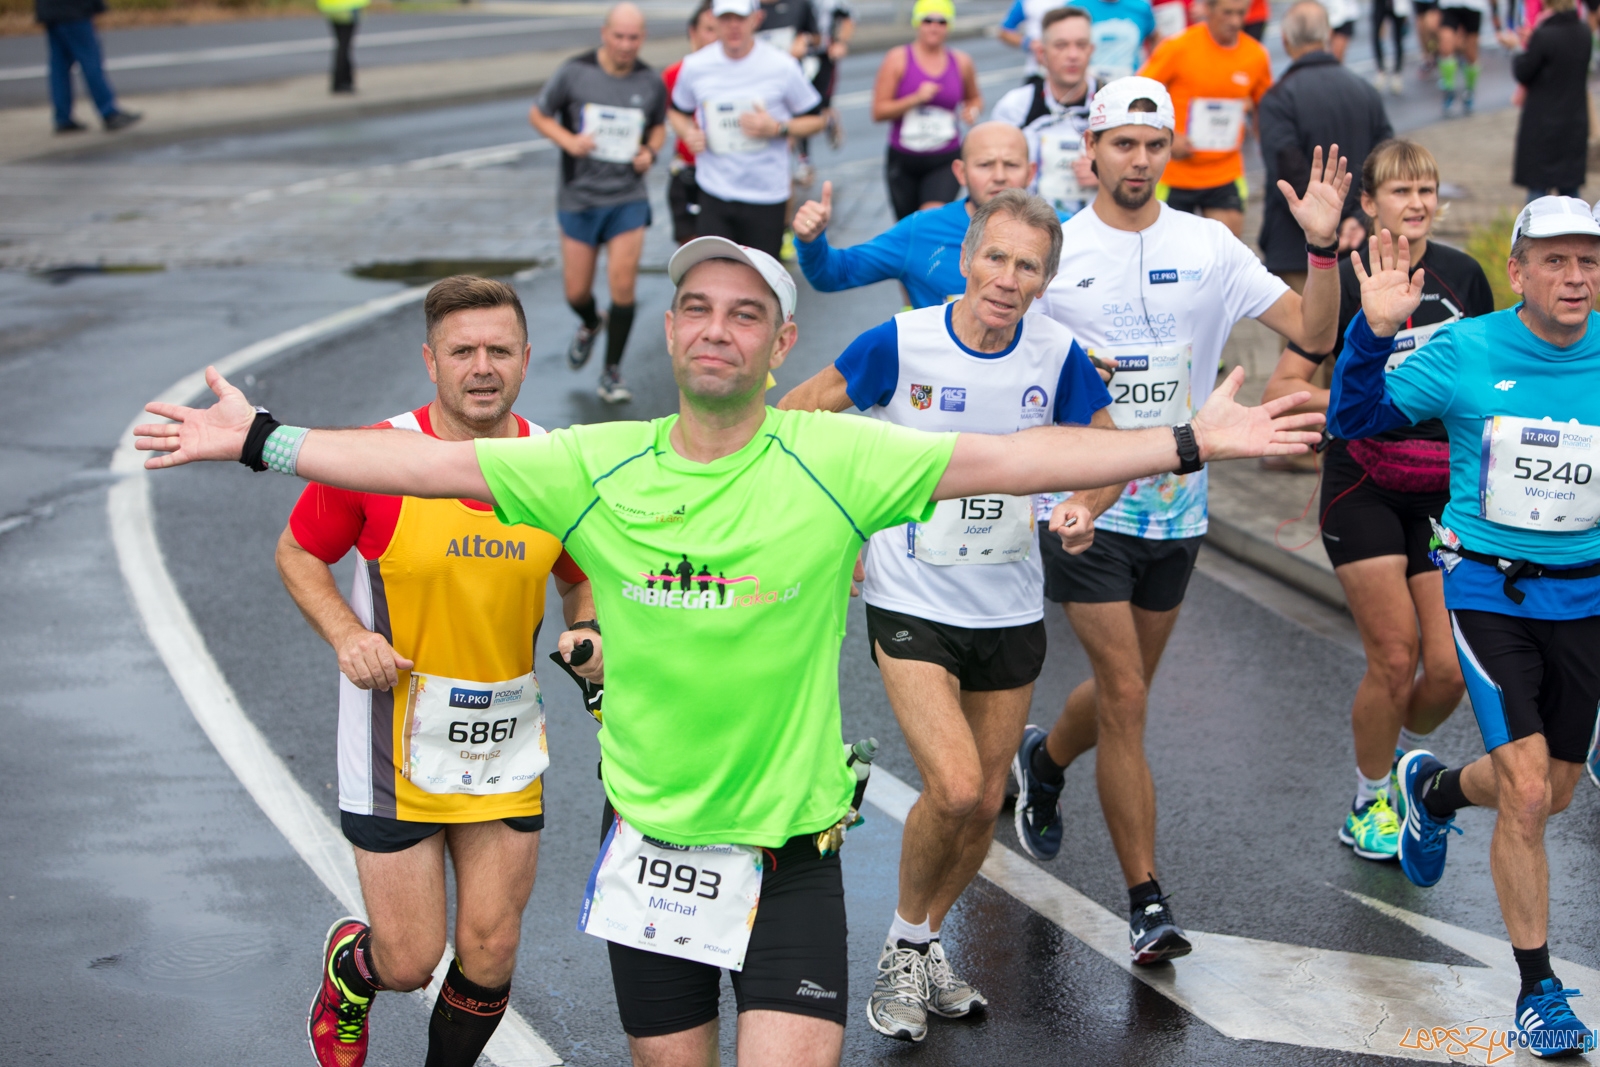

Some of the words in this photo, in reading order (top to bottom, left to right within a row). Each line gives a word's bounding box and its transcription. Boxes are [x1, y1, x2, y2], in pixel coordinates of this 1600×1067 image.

[1077, 277, 1096, 288] 4F
[1102, 302, 1133, 316] SIŁA
[1113, 313, 1176, 328] ODWAGA
[1104, 325, 1176, 342] SZYBKOŚĆ
[1114, 380, 1179, 404] 2067
[1494, 380, 1517, 391] 4F
[1135, 409, 1162, 419] Rafał
[1513, 456, 1593, 485] 5240
[1524, 486, 1576, 501] Wojciech
[960, 498, 1005, 520] 153
[963, 525, 993, 535] Józef
[448, 717, 518, 745] 6861
[460, 750, 501, 761] Dariusz
[637, 855, 722, 900] 1993
[648, 896, 697, 917] Michał
